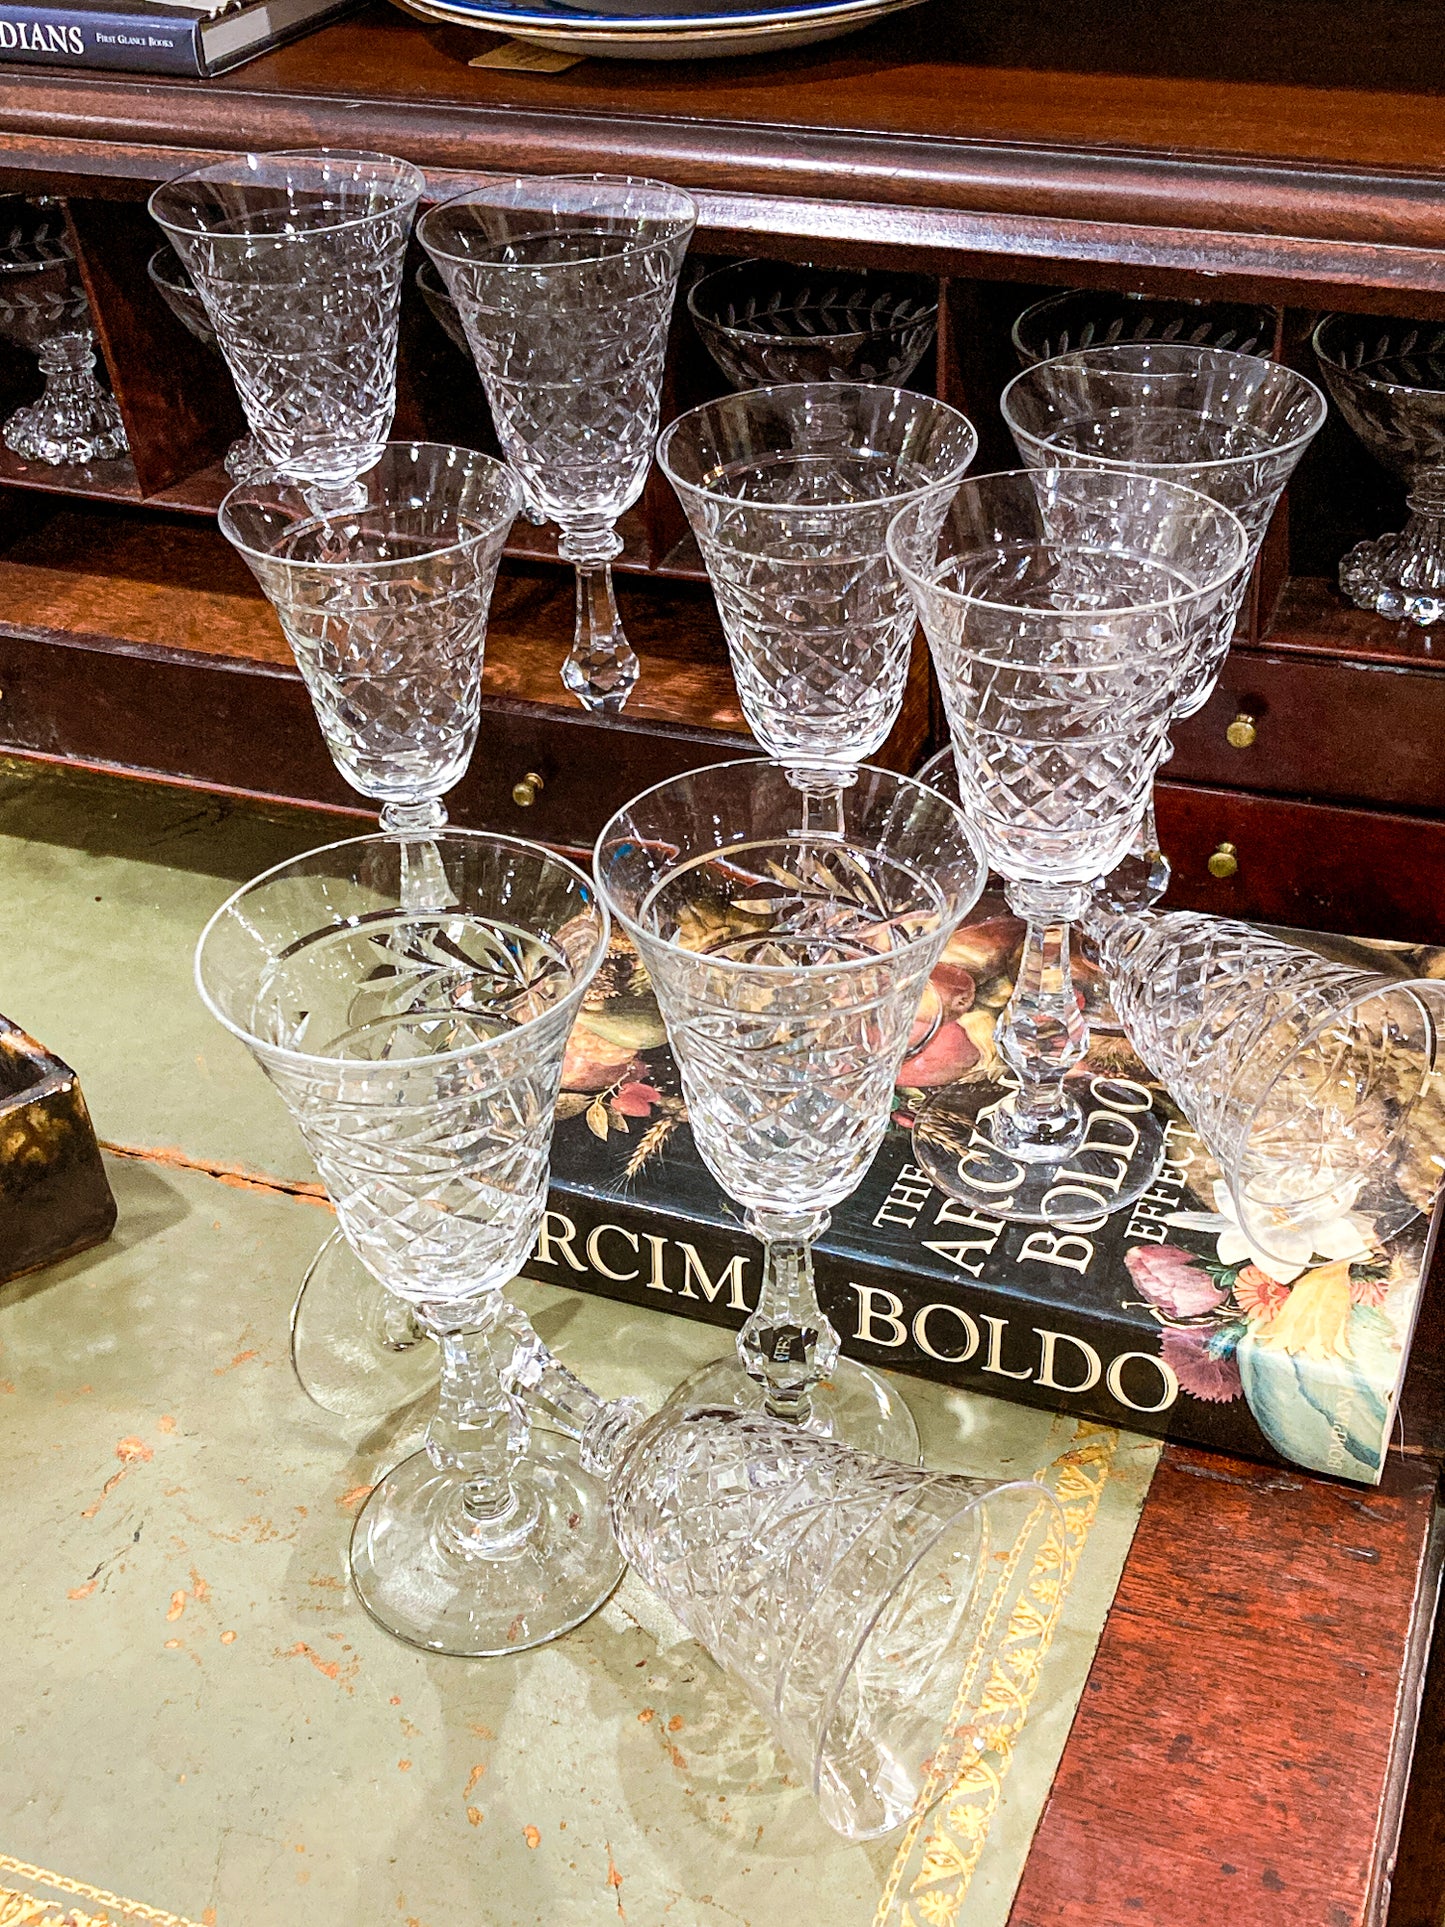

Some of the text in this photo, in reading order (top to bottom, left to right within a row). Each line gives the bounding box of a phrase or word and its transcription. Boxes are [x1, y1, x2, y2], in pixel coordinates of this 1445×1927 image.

[872, 1163, 936, 1229] THE
[1015, 1076, 1153, 1274] BOLDO
[1123, 1119, 1201, 1245] EFFECT
[527, 1210, 1178, 1413] RCIM BOLDO
